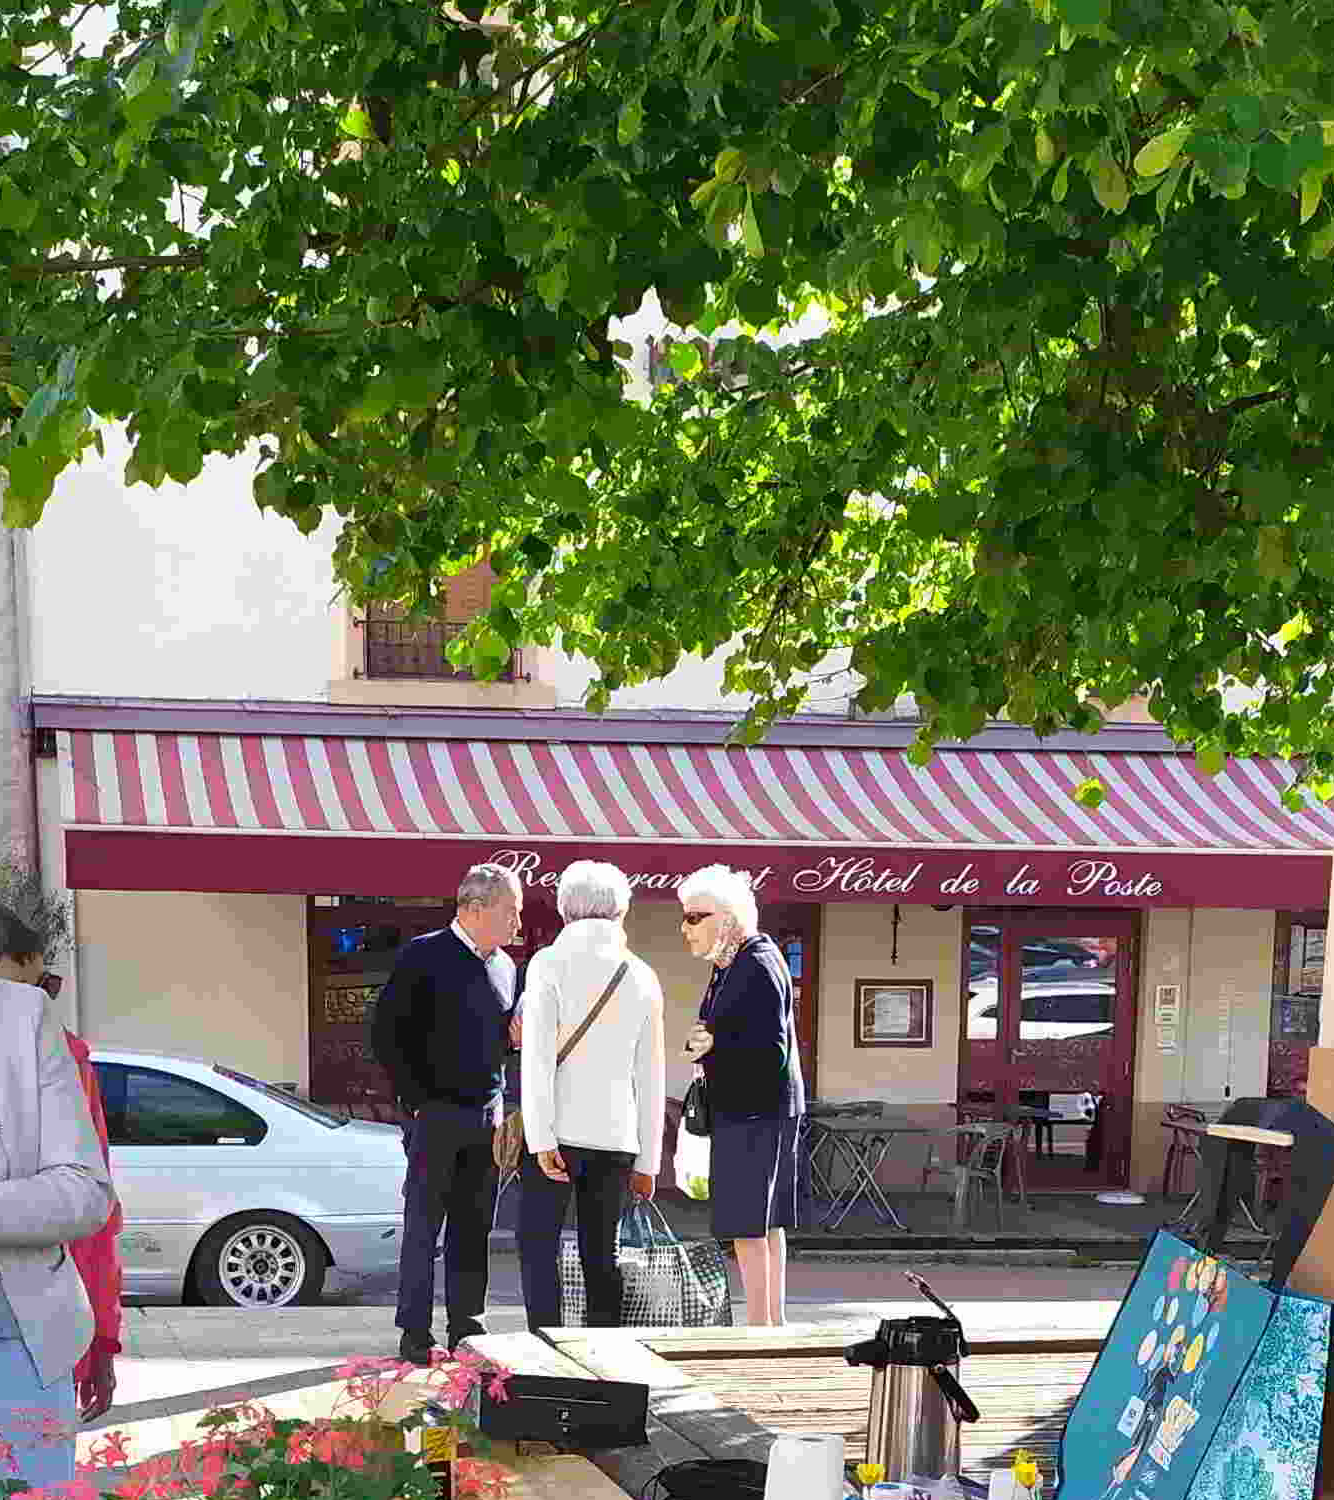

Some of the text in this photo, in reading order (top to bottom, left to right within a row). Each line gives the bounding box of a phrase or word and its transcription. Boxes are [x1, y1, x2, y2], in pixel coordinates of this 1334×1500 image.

[792, 856, 924, 893] Hôtel
[939, 863, 980, 893] de
[1003, 864, 1041, 895] la
[1066, 859, 1162, 897] Poste
